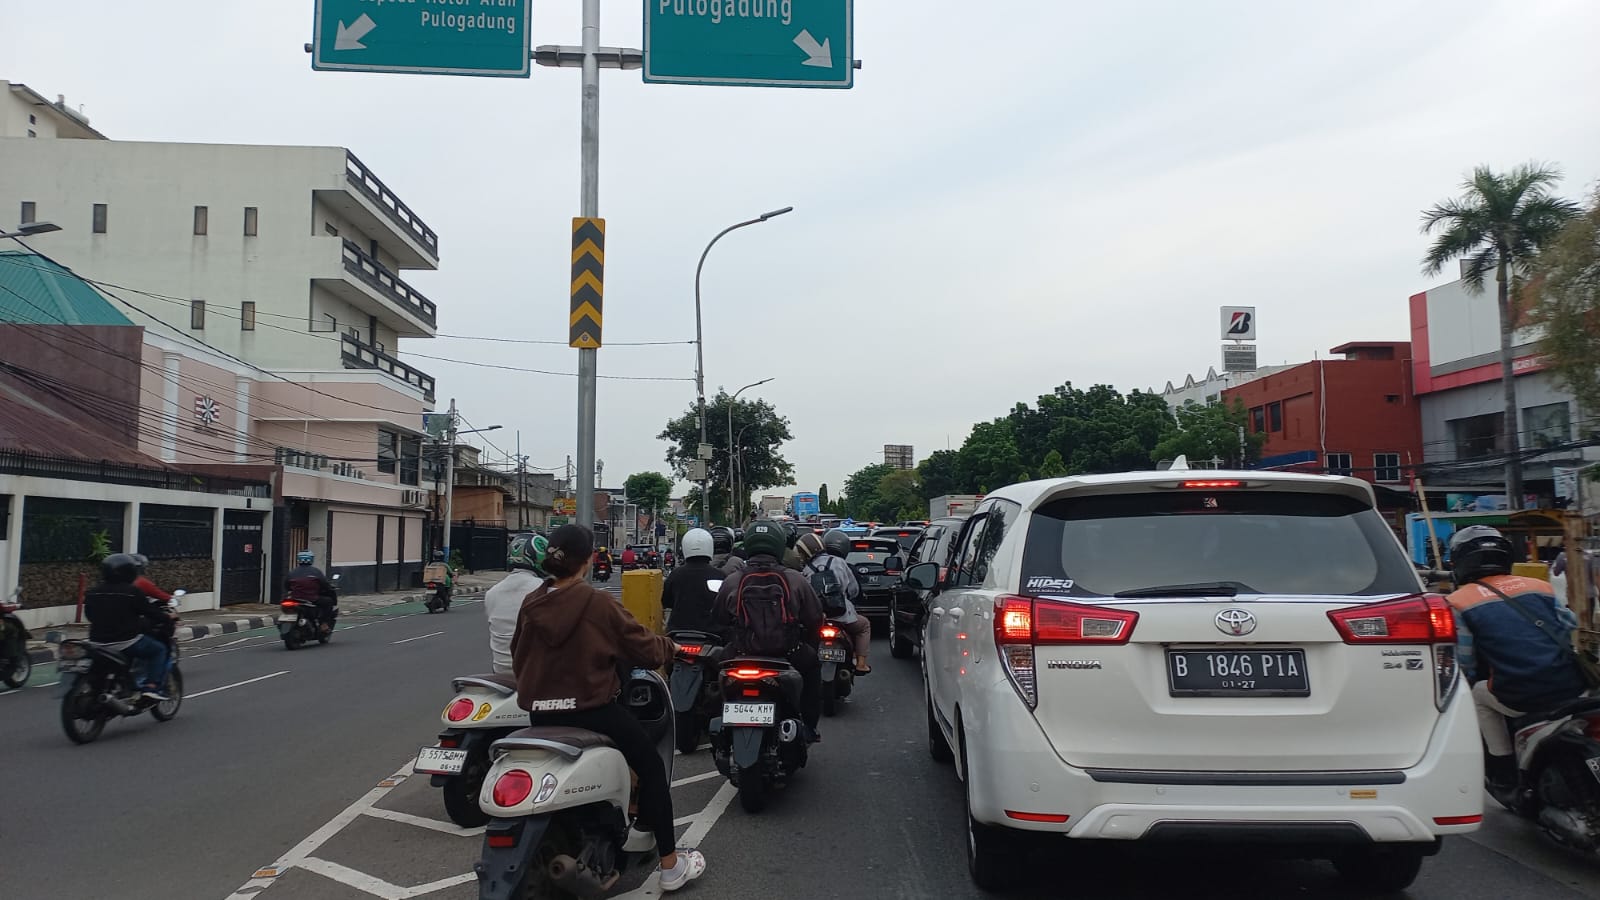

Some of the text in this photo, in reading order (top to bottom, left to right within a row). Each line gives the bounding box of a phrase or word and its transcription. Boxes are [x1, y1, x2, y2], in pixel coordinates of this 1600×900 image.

[659, 0, 792, 26] Pulogadung
[421, 11, 516, 34] Pulogadung
[1047, 660, 1102, 669] INNOVA
[1175, 654, 1299, 677] B 1846 PIA
[532, 698, 577, 711] PREFACE
[724, 704, 730, 713] B
[564, 784, 603, 795] SCOOPY
